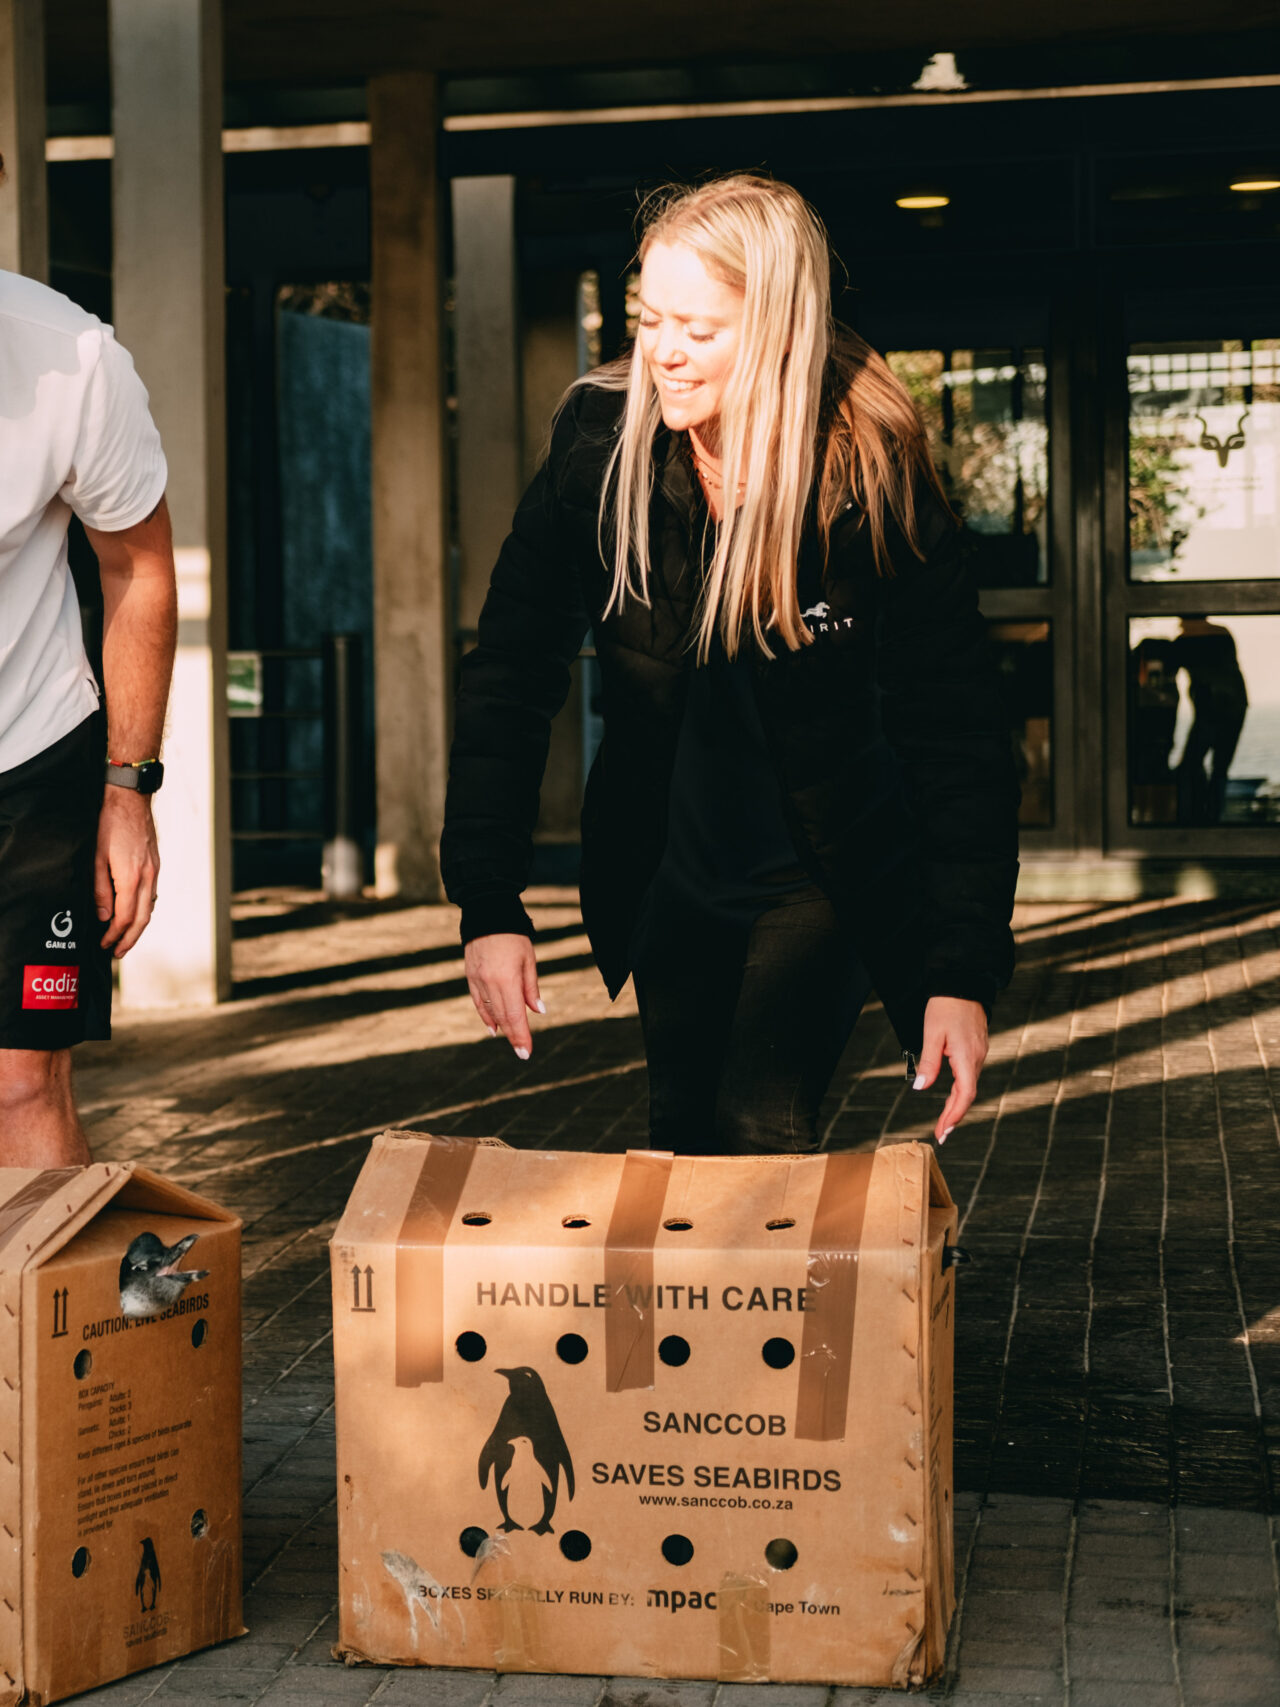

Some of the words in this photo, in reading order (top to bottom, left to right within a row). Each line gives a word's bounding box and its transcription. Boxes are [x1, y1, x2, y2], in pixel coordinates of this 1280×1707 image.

[801, 617, 854, 633] IRIT
[45, 940, 66, 949] GAME
[31, 972, 77, 992] cadiz
[475, 1282, 612, 1308] HANDLE
[625, 1284, 708, 1310] WITH
[722, 1286, 816, 1312] CARE
[643, 1411, 787, 1436] SANCCOB
[592, 1462, 685, 1487] SAVES
[694, 1466, 842, 1492] SEABIRDS
[639, 1495, 793, 1510] www.sanccob.co.za
[417, 1585, 472, 1600] BOXES
[569, 1591, 603, 1605] RUN
[609, 1593, 634, 1606] BY:
[646, 1589, 718, 1614] mpac
[798, 1601, 841, 1616] Town
